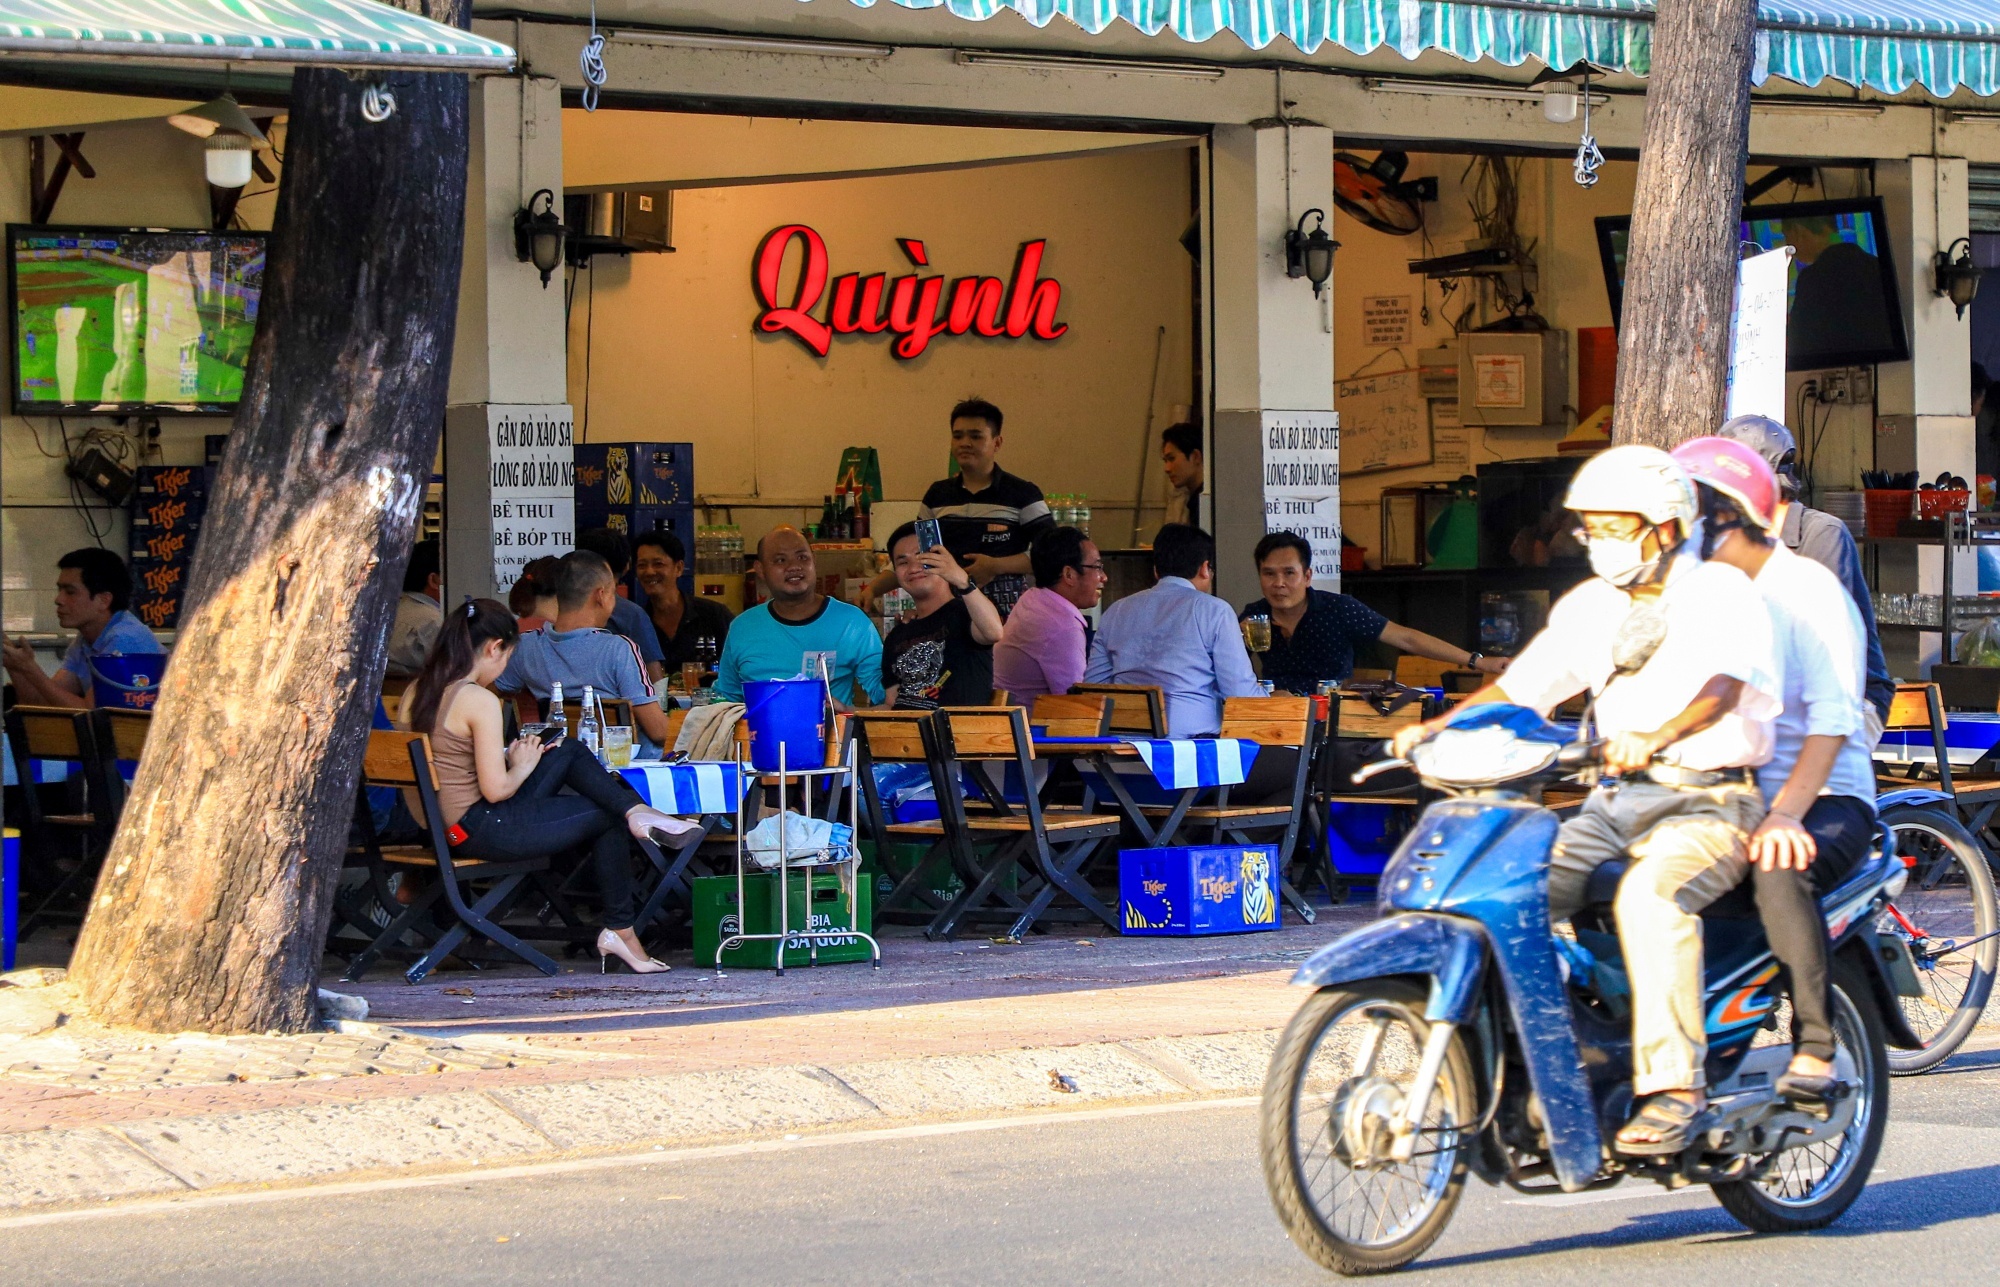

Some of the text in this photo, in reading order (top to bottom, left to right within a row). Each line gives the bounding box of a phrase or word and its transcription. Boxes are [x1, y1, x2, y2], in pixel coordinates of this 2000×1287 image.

[752, 223, 1068, 359] Quỳnh
[497, 414, 517, 447] GÂN
[520, 413, 534, 447] BÒ
[536, 413, 556, 447] XÀO
[1288, 419, 1300, 450] BÒ
[1300, 419, 1318, 450] XÀO
[154, 467, 192, 497] Tiger
[493, 453, 519, 487] LÒNG
[522, 453, 536, 487] BÒ
[538, 453, 558, 487] XÀO
[575, 465, 604, 487] Tiger
[1266, 456, 1288, 486] LÒNG
[1289, 456, 1300, 486] BÒ
[1302, 456, 1319, 486] XÀO
[148, 499, 187, 530] Tiger
[492, 499, 555, 518] BÊ THUI
[1266, 497, 1316, 515] BÊ THUI
[147, 531, 186, 562] Tiger
[494, 527, 575, 546] BÊ BÓP TH
[981, 532, 1011, 543] FENDI
[144, 564, 181, 594] Tiger
[140, 596, 176, 627] Tiger
[1142, 879, 1168, 896] Tiger
[1199, 875, 1238, 904] Tiger
[811, 914, 832, 927] BIA
